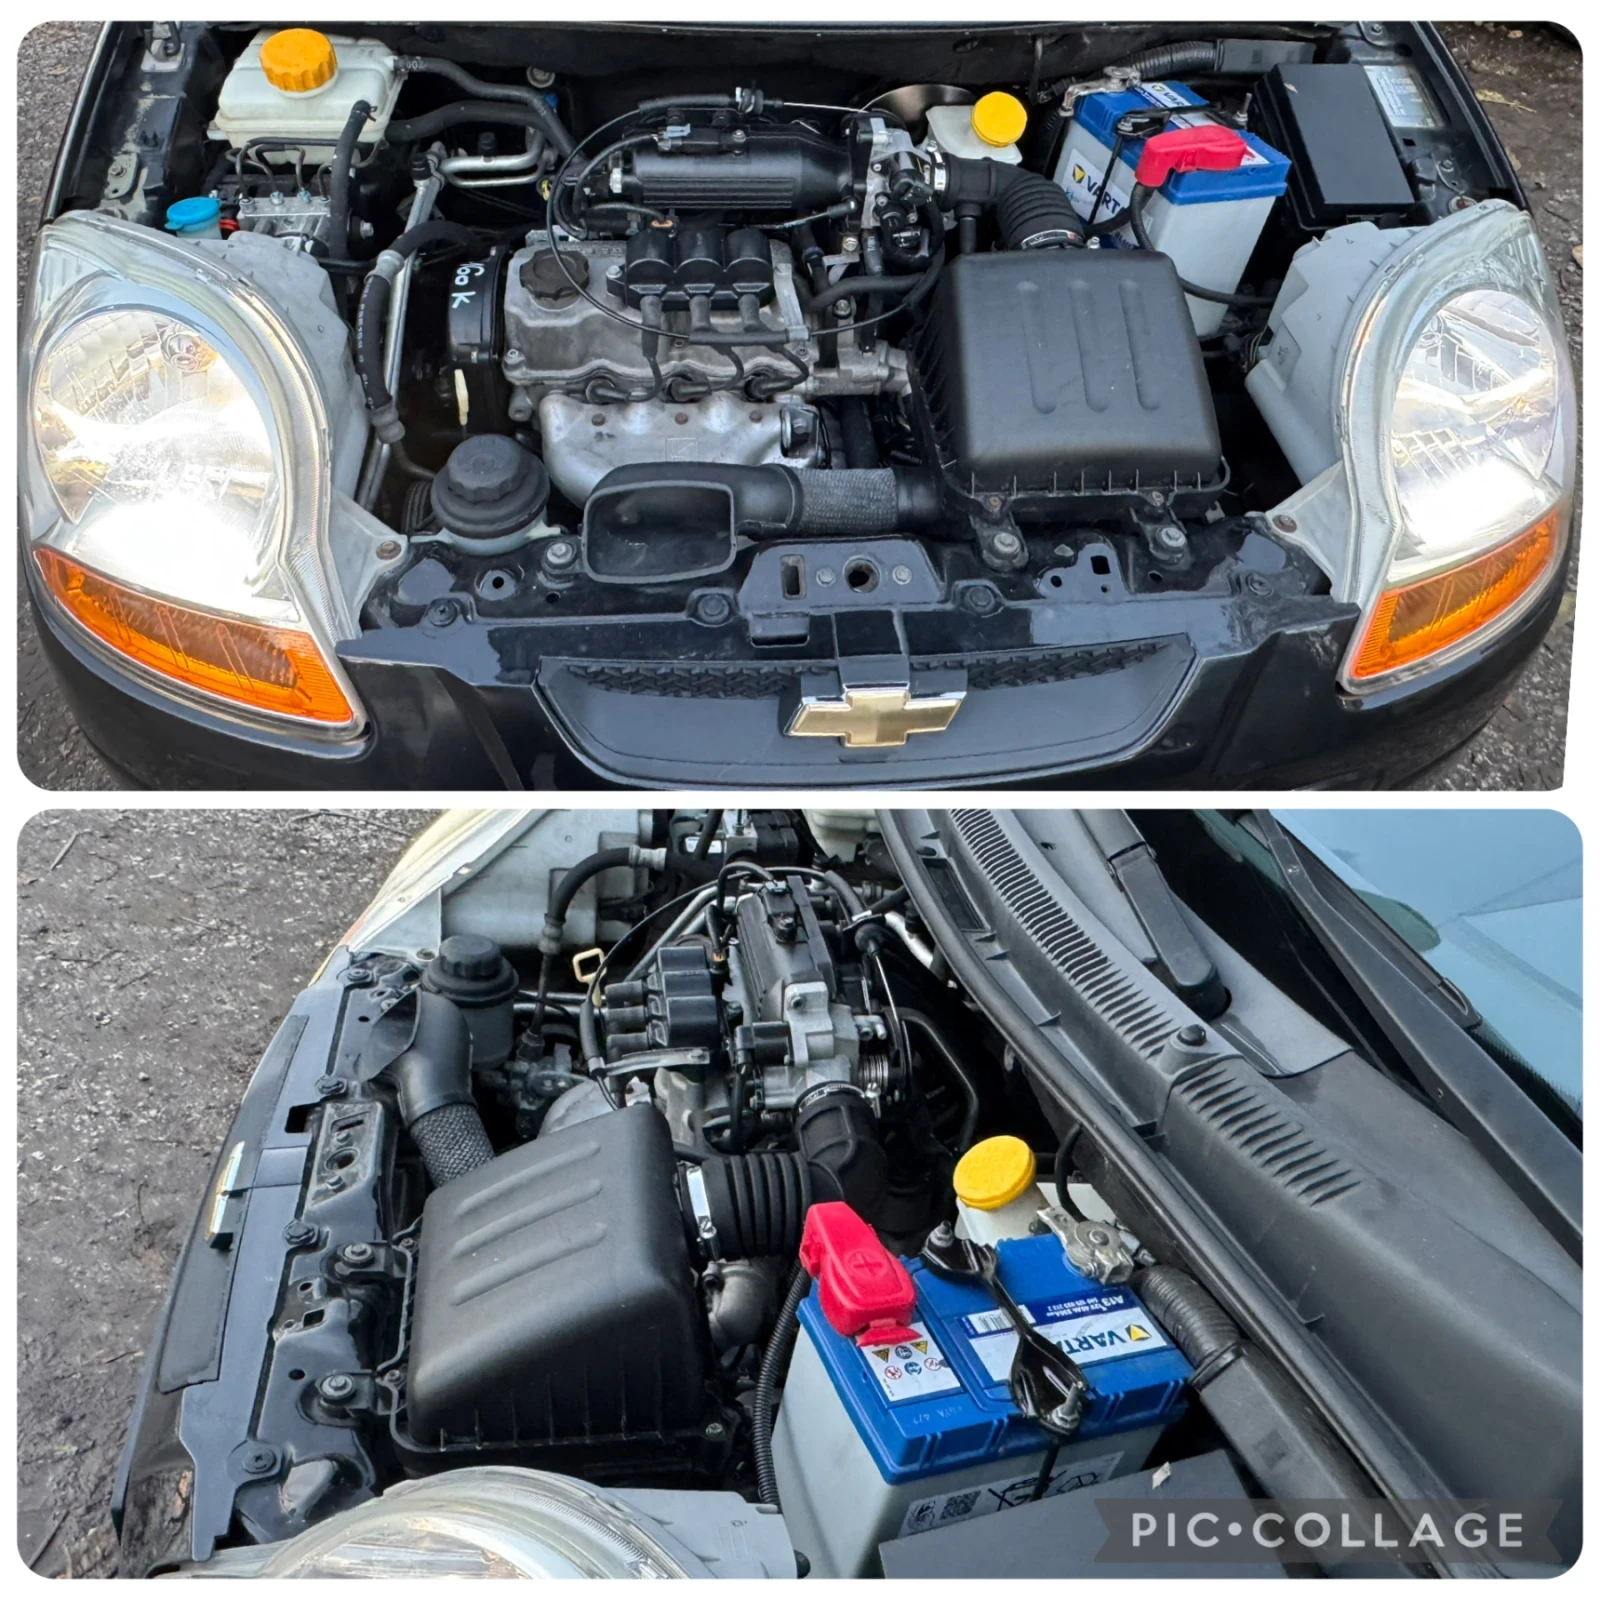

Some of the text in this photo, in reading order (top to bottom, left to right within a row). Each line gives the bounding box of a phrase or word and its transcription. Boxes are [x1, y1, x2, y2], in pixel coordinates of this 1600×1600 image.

[1164, 92, 1185, 106] VAR
[1086, 175, 1121, 214] VART
[1101, 1295, 1124, 1307] A13
